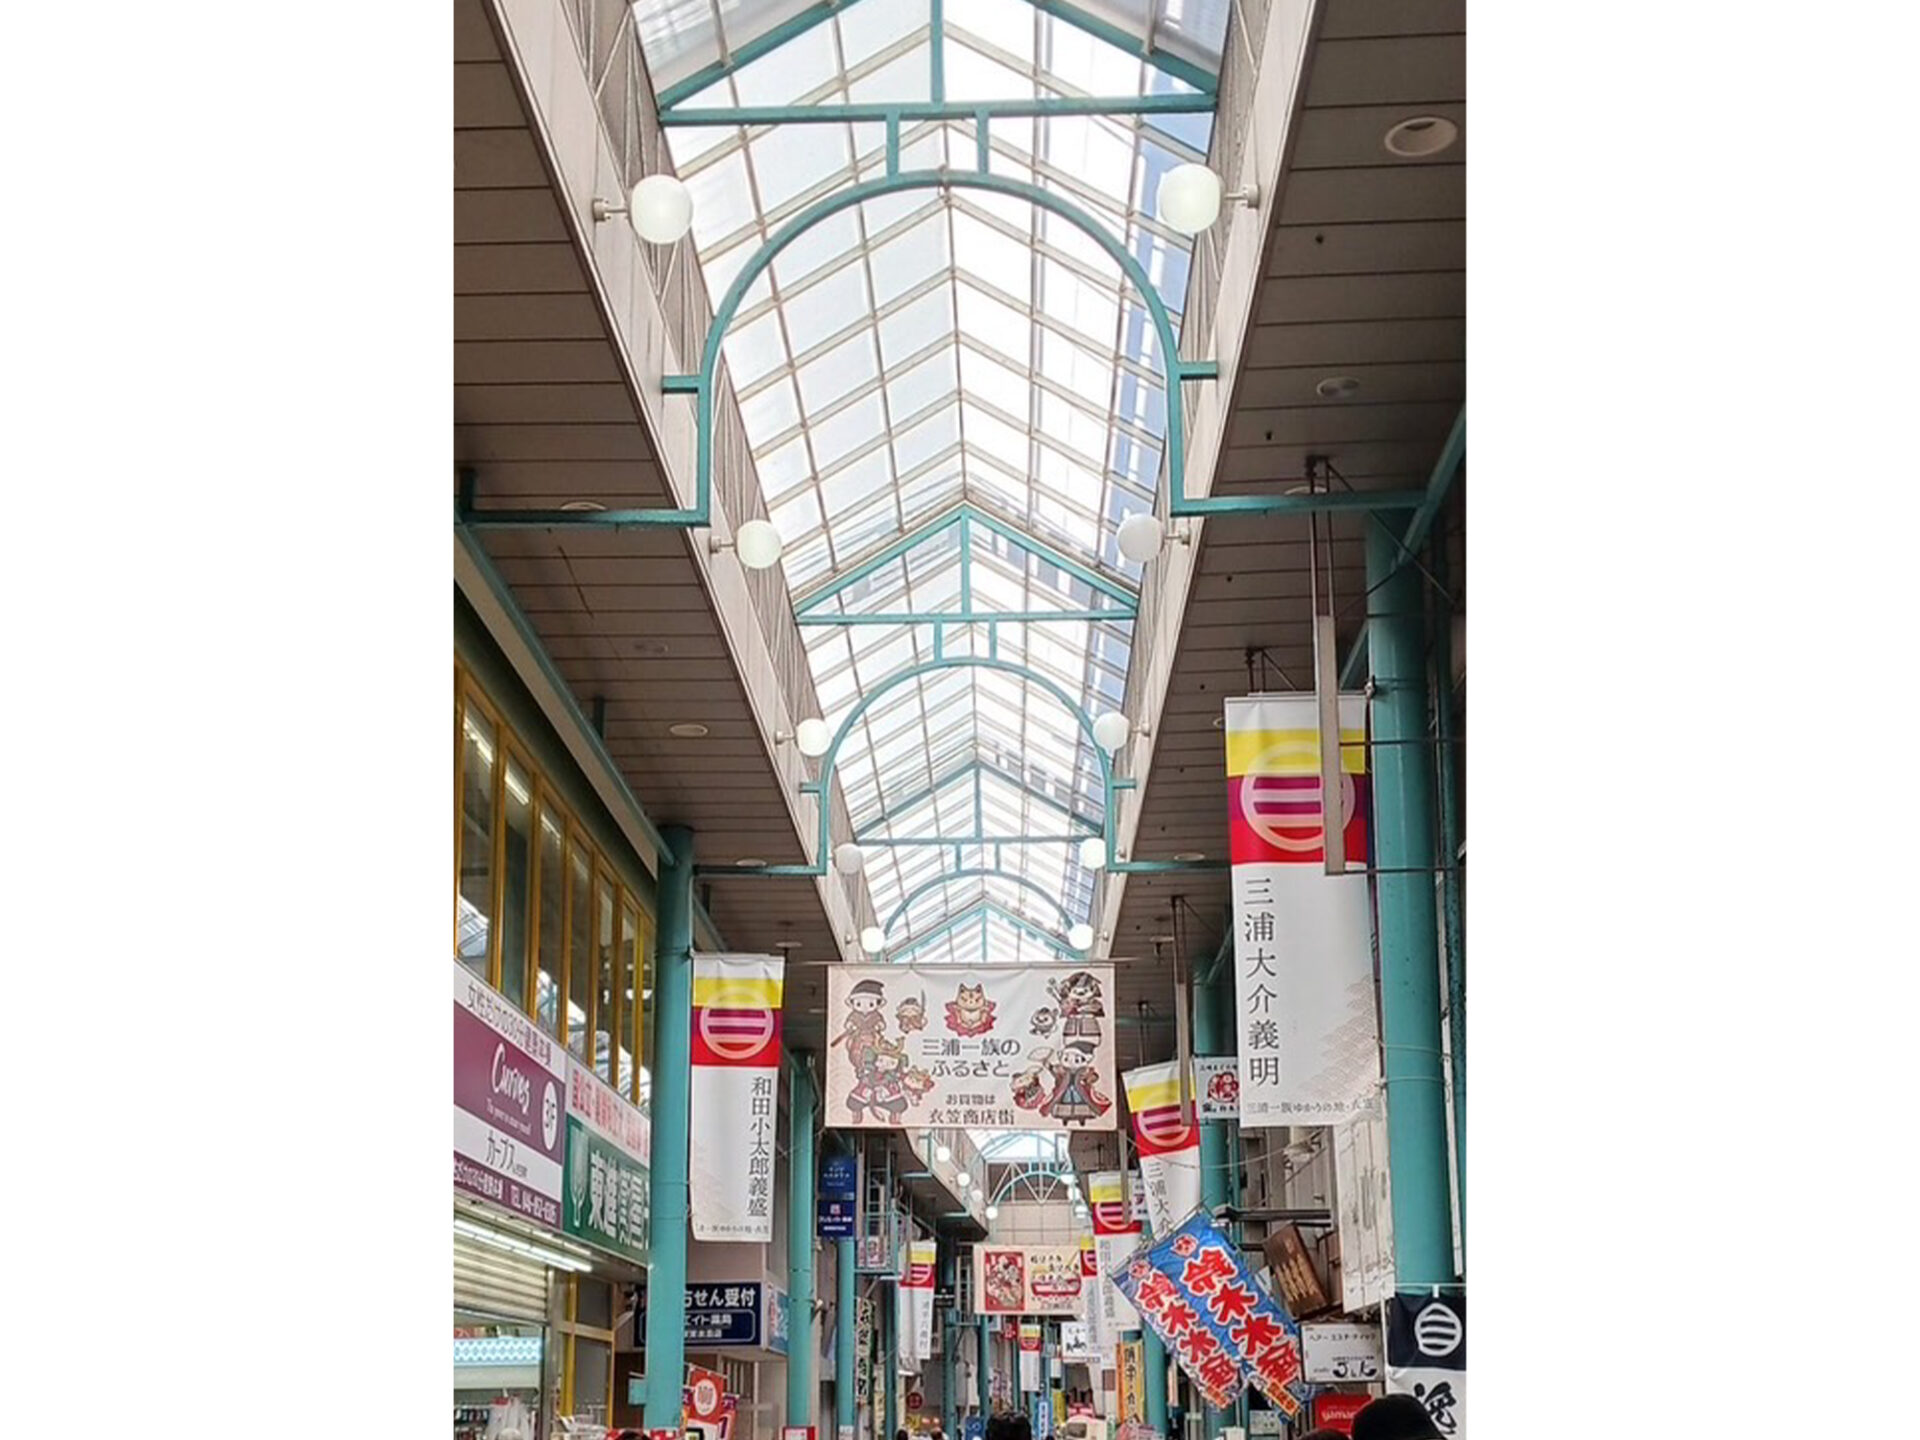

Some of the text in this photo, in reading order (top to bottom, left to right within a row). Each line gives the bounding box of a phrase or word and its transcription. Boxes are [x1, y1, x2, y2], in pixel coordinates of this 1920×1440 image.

[1244, 878, 1279, 1086] 三浦大介義明
[922, 1038, 1021, 1056] 三浦一族の
[492, 1042, 530, 1114] Curves
[931, 1060, 1012, 1078] ふるさと
[945, 1094, 996, 1105] お買物は
[929, 1109, 1016, 1126] 衣笠商店街
[748, 1076, 772, 1217] 和田小太郎義盛
